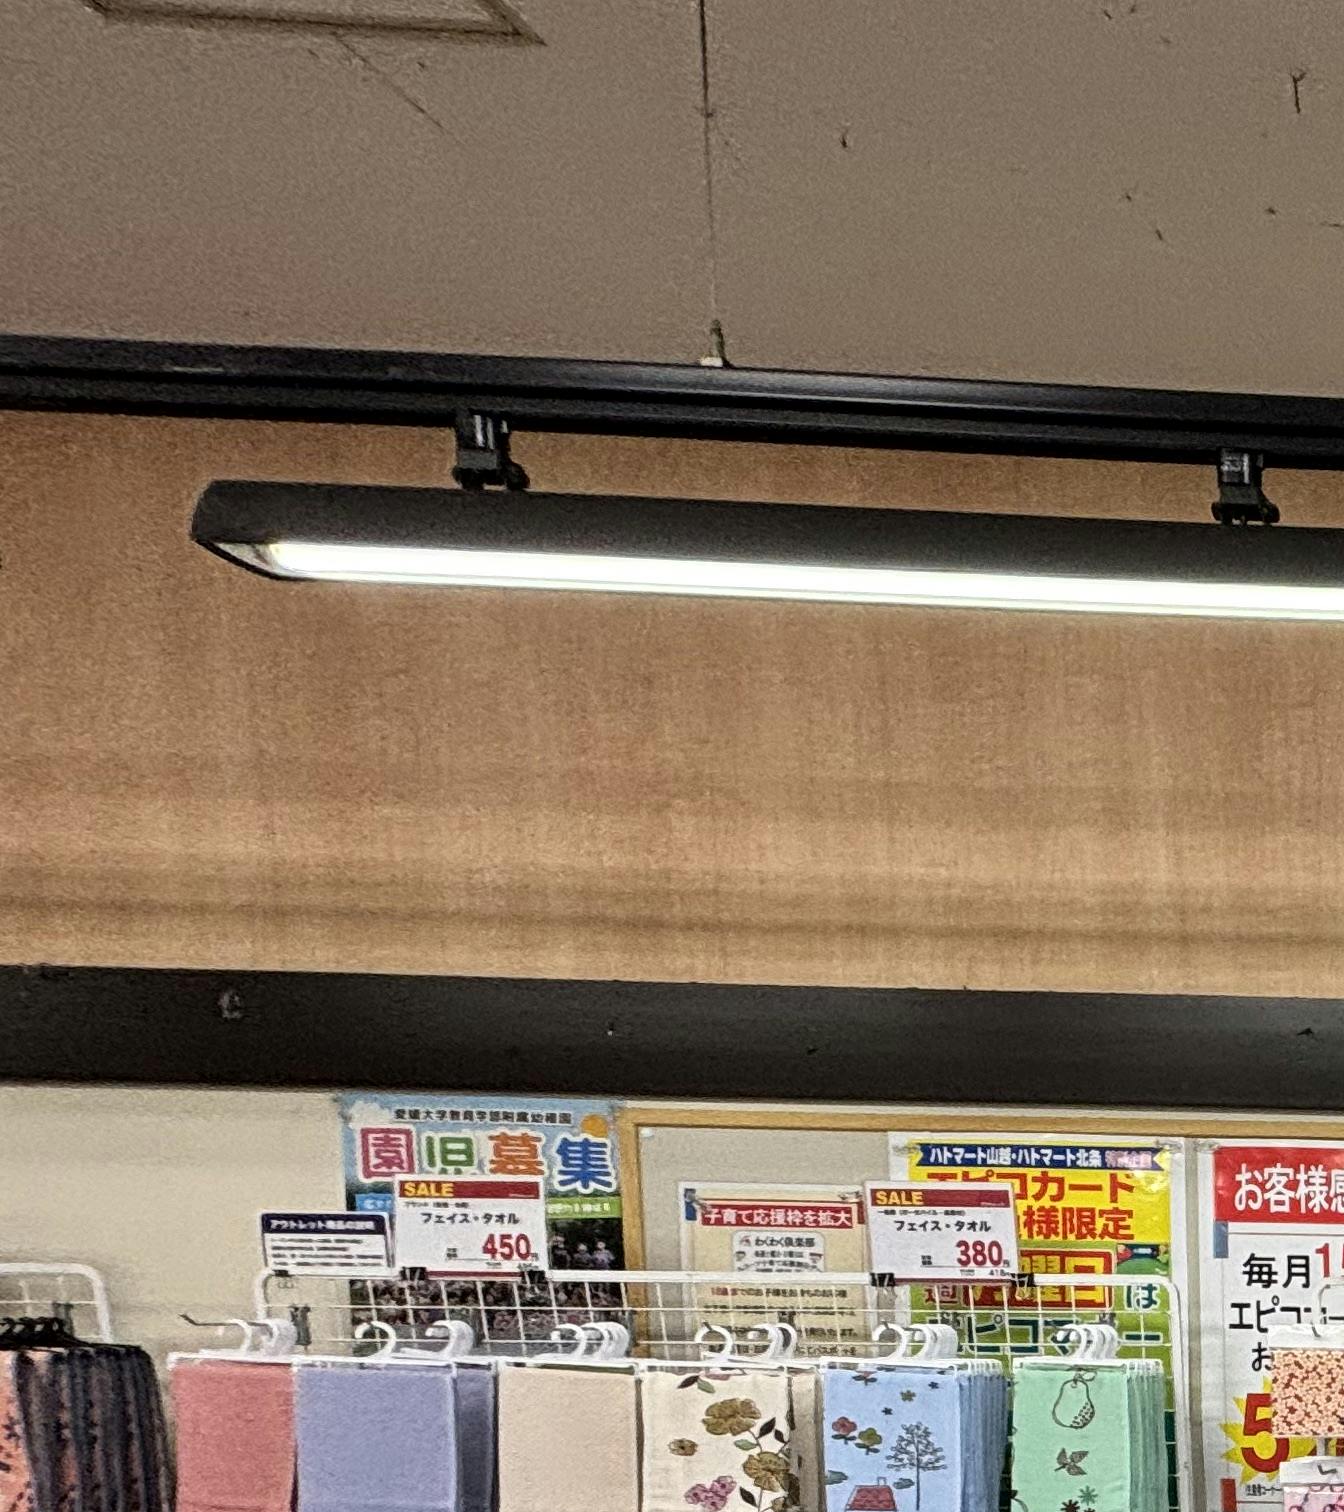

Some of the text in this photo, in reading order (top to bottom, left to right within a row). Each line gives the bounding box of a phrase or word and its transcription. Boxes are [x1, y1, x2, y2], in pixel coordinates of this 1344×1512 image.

[404, 1182, 455, 1197] SALE
[927, 1169, 1135, 1203] コカード
[875, 1191, 924, 1205] SALE
[421, 1212, 520, 1225] フェイス・タオル
[705, 1208, 852, 1226] 子育て応援枠を拡大
[1017, 1206, 1135, 1240] 様限定
[894, 1220, 992, 1232] フェイス・タオル
